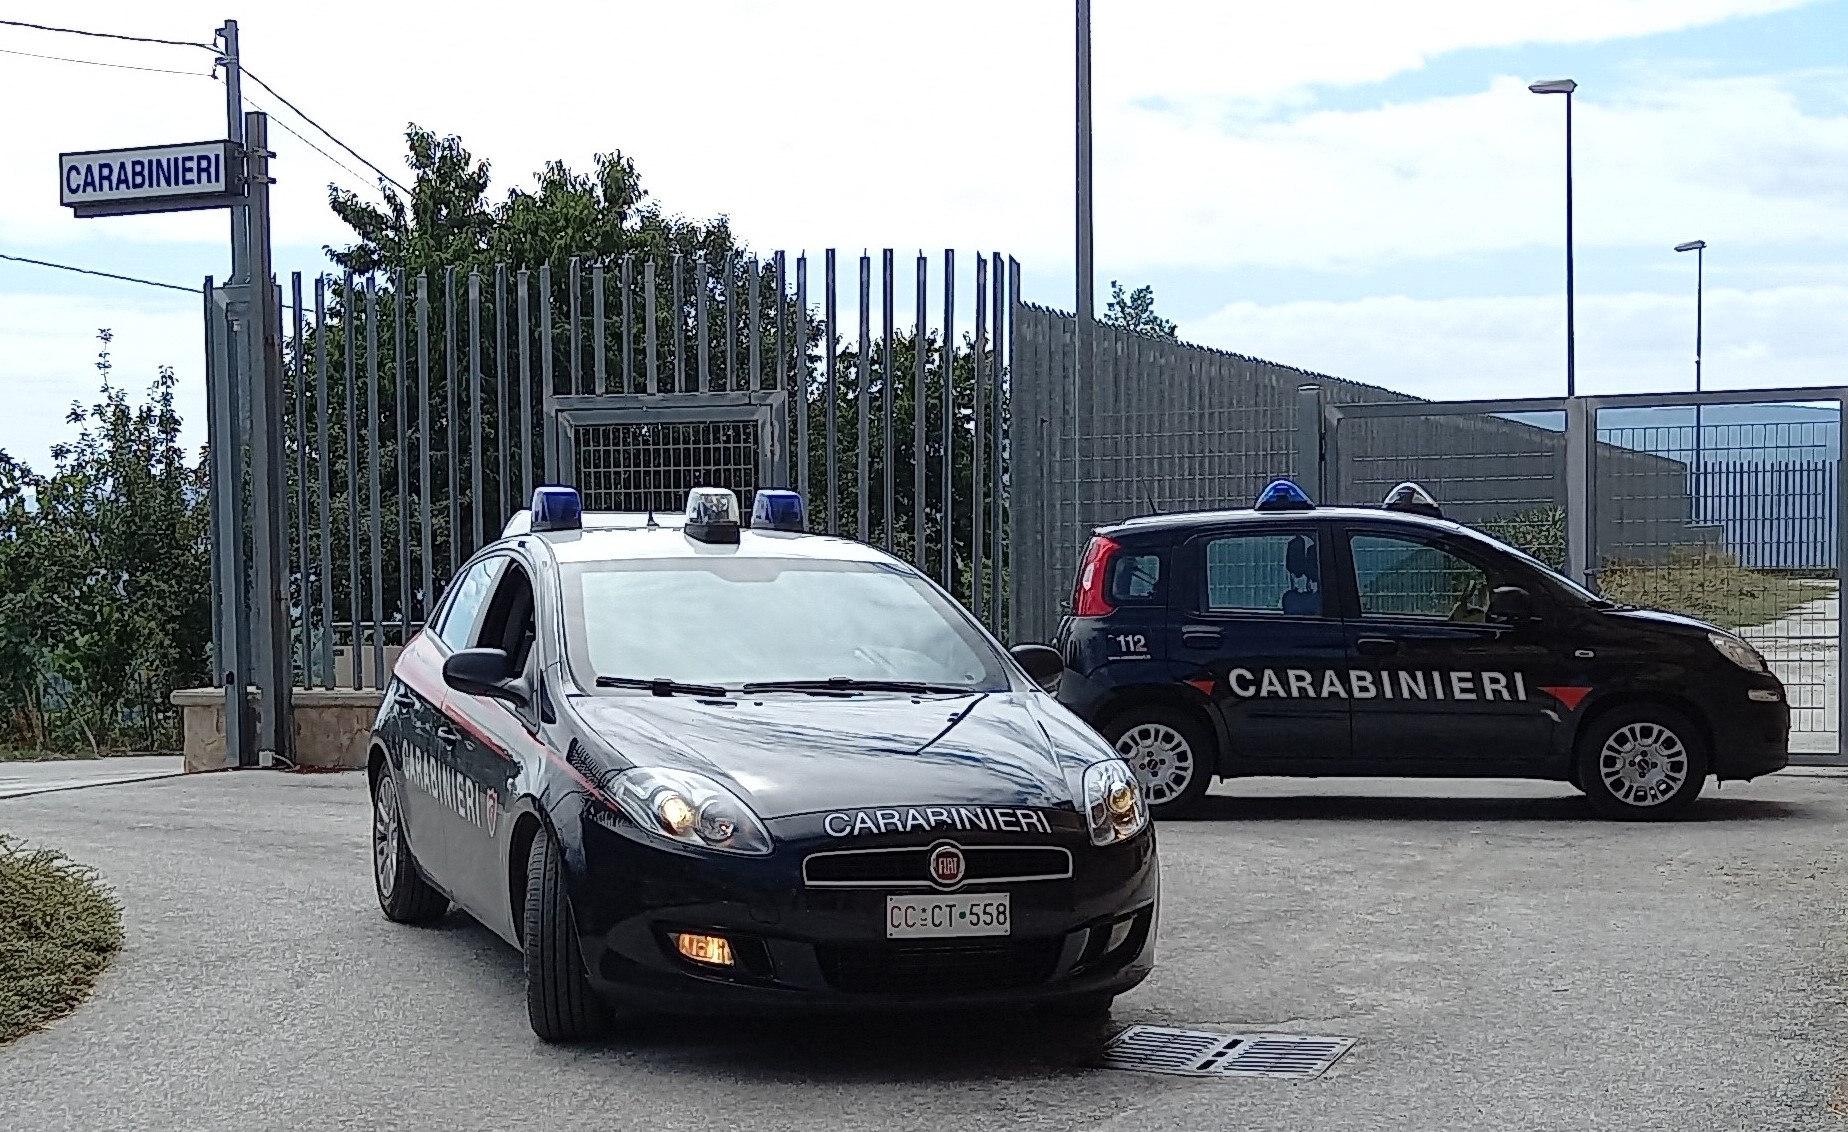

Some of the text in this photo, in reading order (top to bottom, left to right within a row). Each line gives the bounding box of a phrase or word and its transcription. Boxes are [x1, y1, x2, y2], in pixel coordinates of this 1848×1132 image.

[66, 153, 220, 194] CARABINIERI
[1116, 634, 1148, 652] 112
[1228, 667, 1528, 701] CARABINIERI
[401, 738, 482, 829] CARABINIERI
[938, 857, 959, 875] FIAT
[968, 902, 1008, 927] 558
